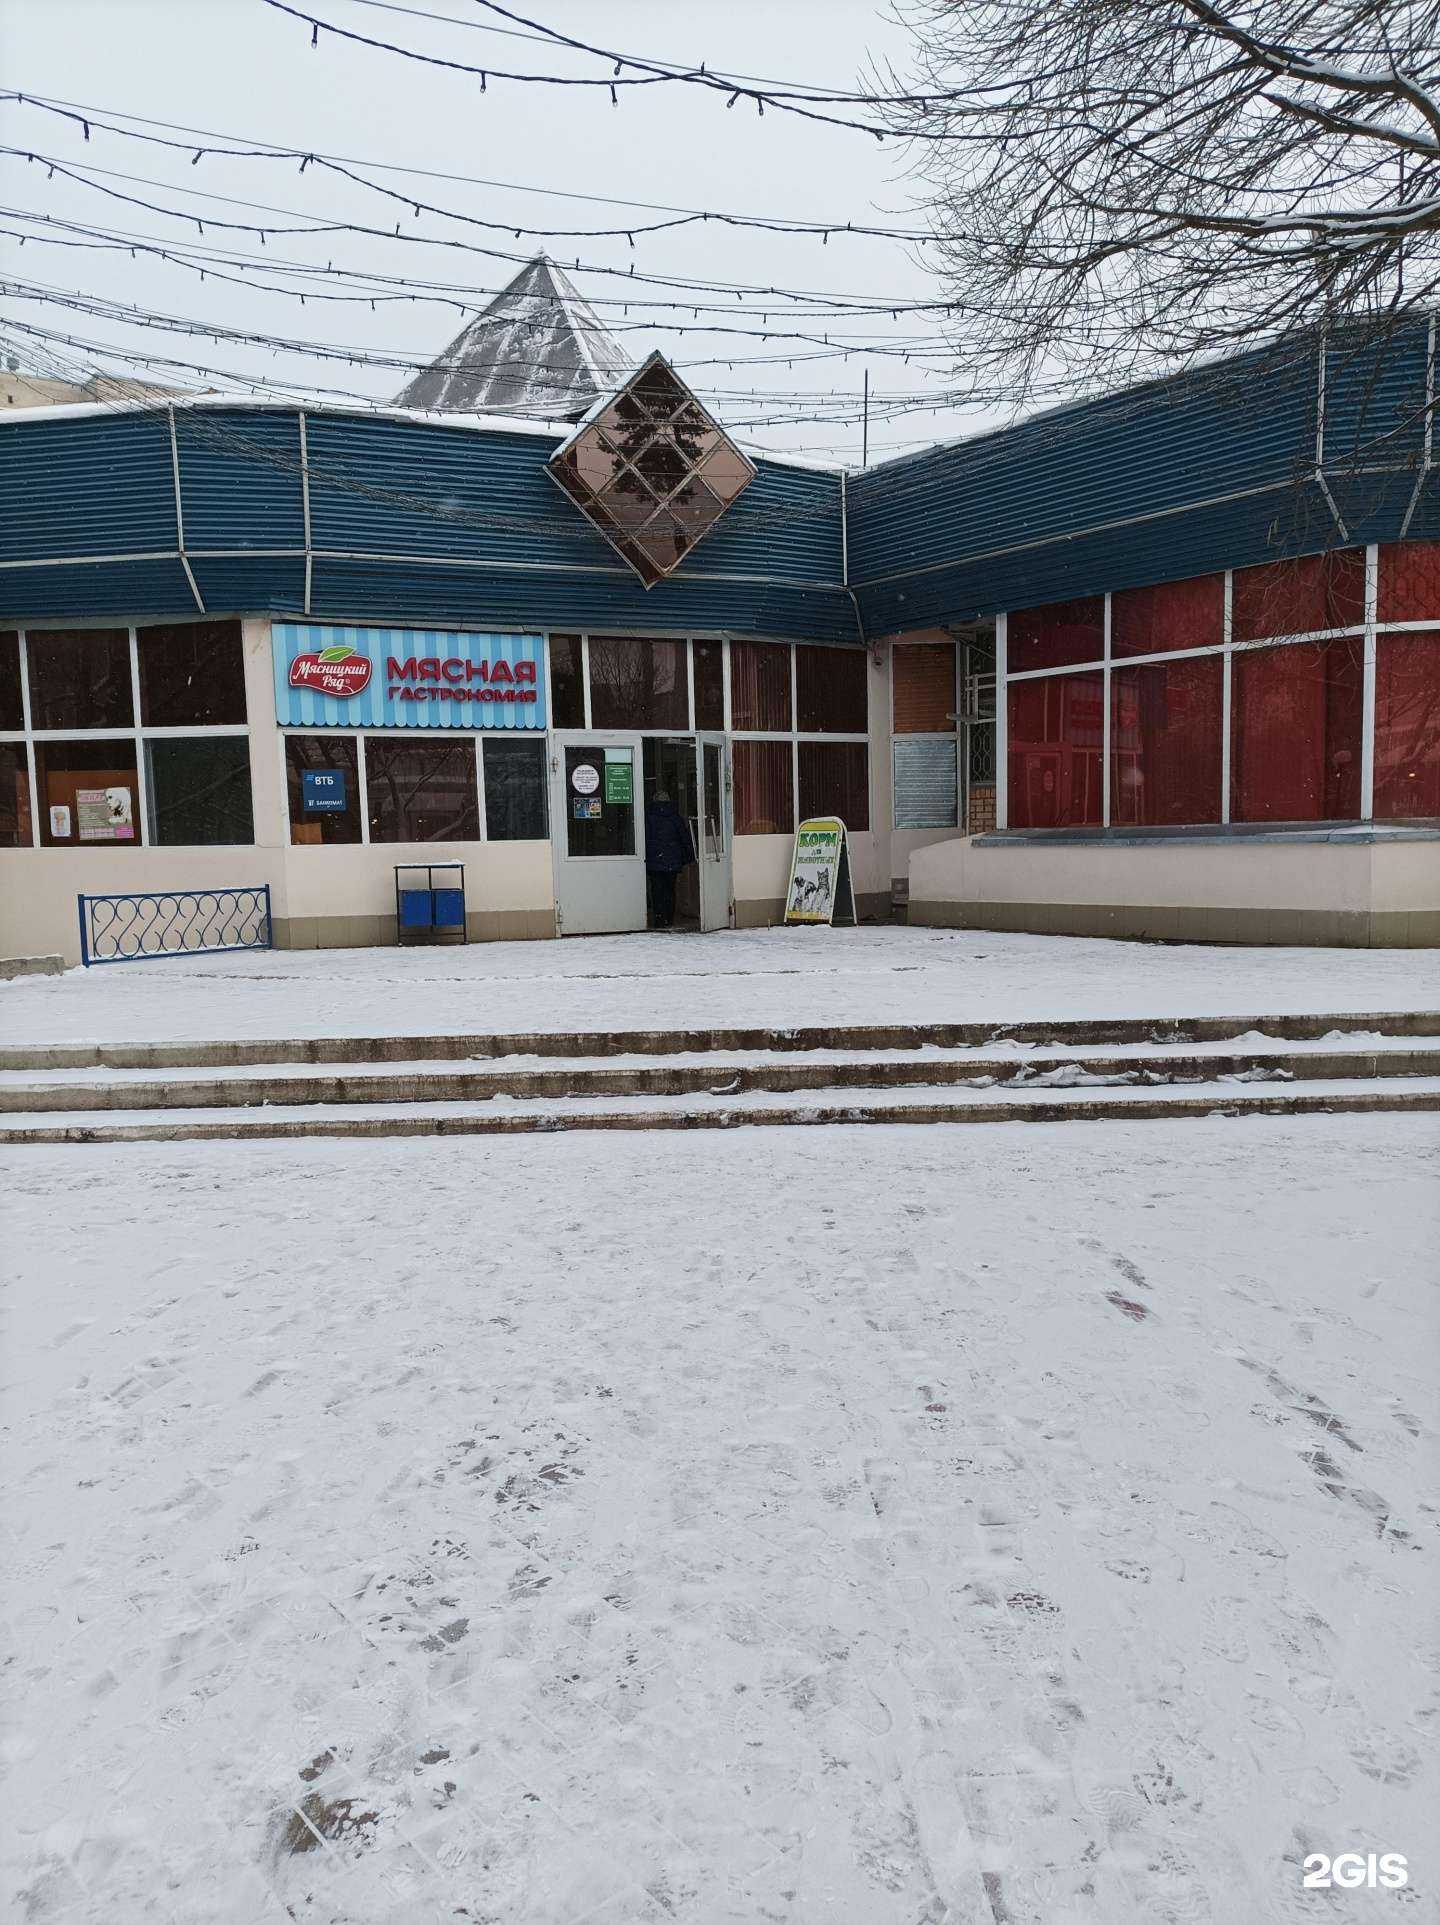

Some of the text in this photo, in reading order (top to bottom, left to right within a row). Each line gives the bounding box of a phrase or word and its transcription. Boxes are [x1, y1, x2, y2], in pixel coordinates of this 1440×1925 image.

[293, 661, 367, 680] Мясницкий
[386, 656, 536, 683] МЯСНАЯ
[322, 674, 345, 690] Ряд
[388, 686, 537, 703] ГАСТРОНОМИЯ
[315, 775, 334, 785] ВТБ
[798, 832, 837, 848] КОРМ
